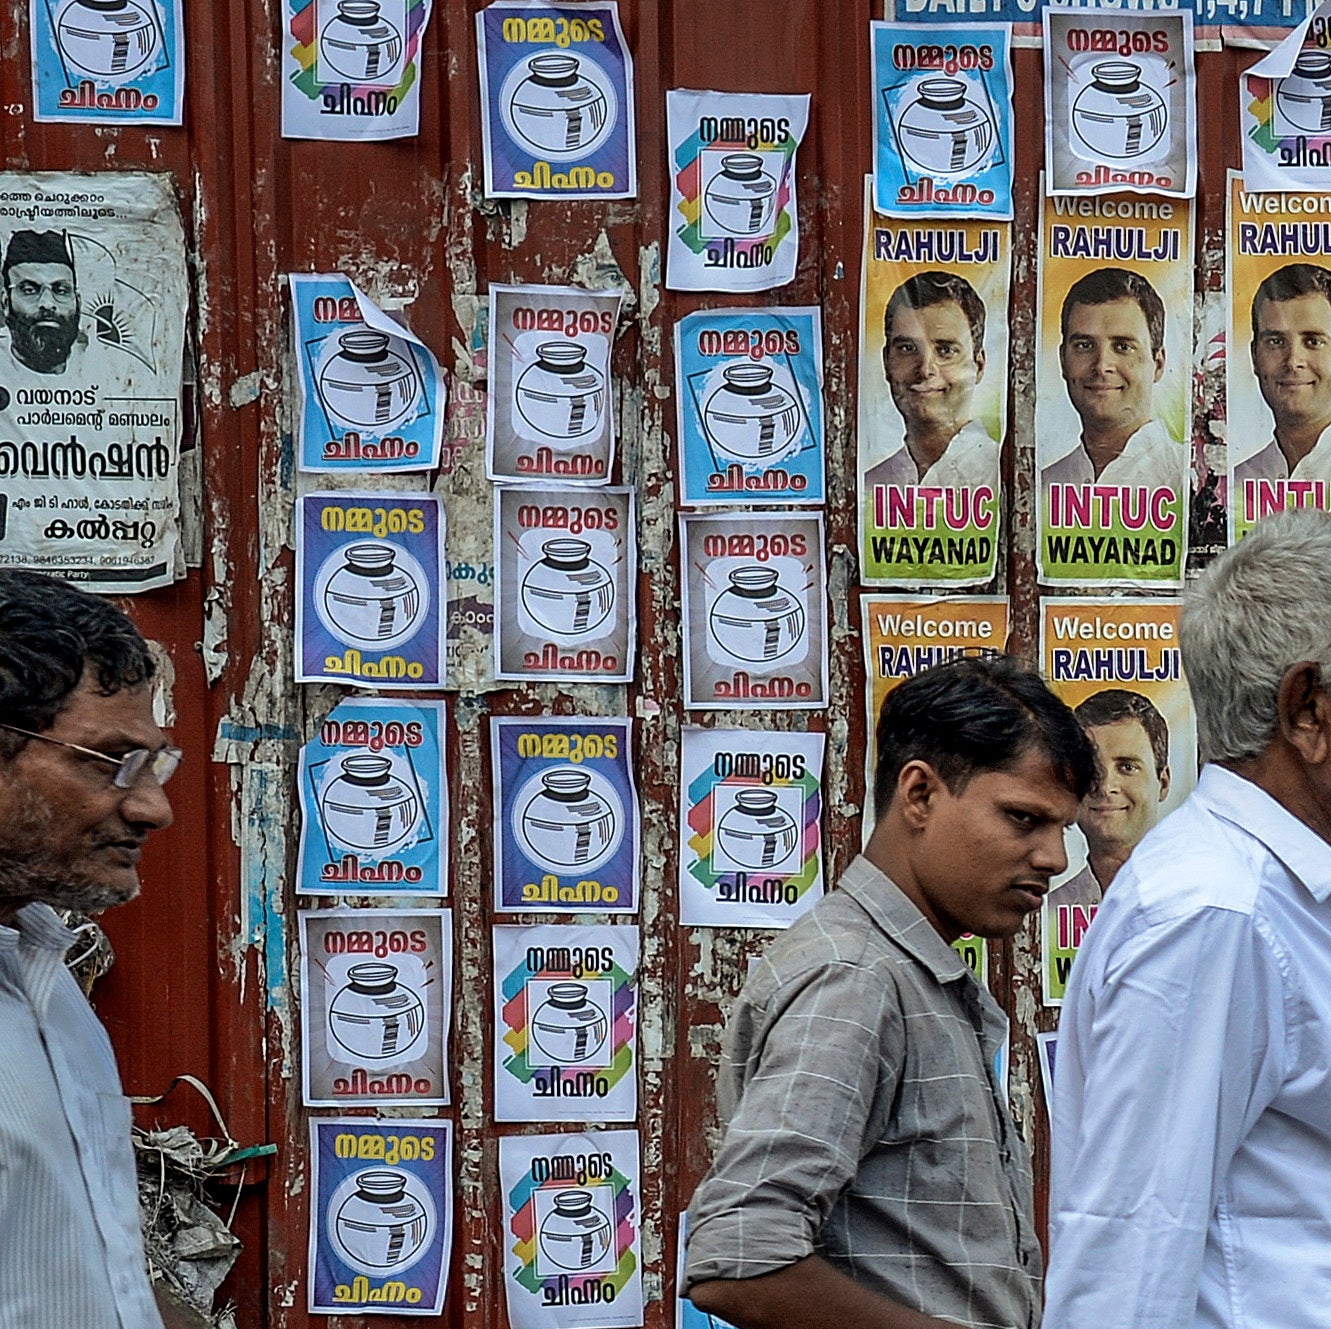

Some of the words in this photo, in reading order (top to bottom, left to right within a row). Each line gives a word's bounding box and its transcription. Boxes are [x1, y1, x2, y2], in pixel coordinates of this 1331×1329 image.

[501, 16, 604, 45] നമ്മുടെ
[893, 42, 995, 71] നമ്മുടെ
[57, 80, 159, 111] ചിഹ്നം
[697, 115, 790, 148] നമ്മുടെ
[514, 163, 614, 191] ചിഹ്നം
[895, 184, 993, 207] ചിഹ്നം
[1051, 196, 1173, 220] Welcome
[702, 243, 773, 270] ചിഹ്നം
[873, 228, 999, 262] RAHULJI
[1050, 226, 1180, 259] RAHULJI
[16, 385, 99, 405] വയനാട്
[109, 412, 170, 426] മണ്ഡലം
[0, 434, 170, 480] വെൻഷൻ
[873, 485, 994, 529] INTUC
[1050, 483, 1175, 527] INTUC
[320, 506, 424, 537] നമ്മുടെ
[872, 537, 991, 566] WAYANAD
[1048, 535, 1176, 566] WAYANAD
[878, 613, 993, 638] Welcome
[1053, 616, 1173, 642] Welcome
[323, 652, 422, 679] ചിഹ്നം
[1054, 648, 1180, 682] RAHULJI
[320, 719, 422, 748] നമ്മുടെ
[321, 855, 422, 882] ചിഹ്നം
[526, 946, 614, 975] നമ്മുടെ
[533, 1072, 608, 1098] ചിഹ്നം
[334, 1133, 434, 1163] നമ്മുടെ
[332, 1279, 421, 1305] ചിഹ്നം
